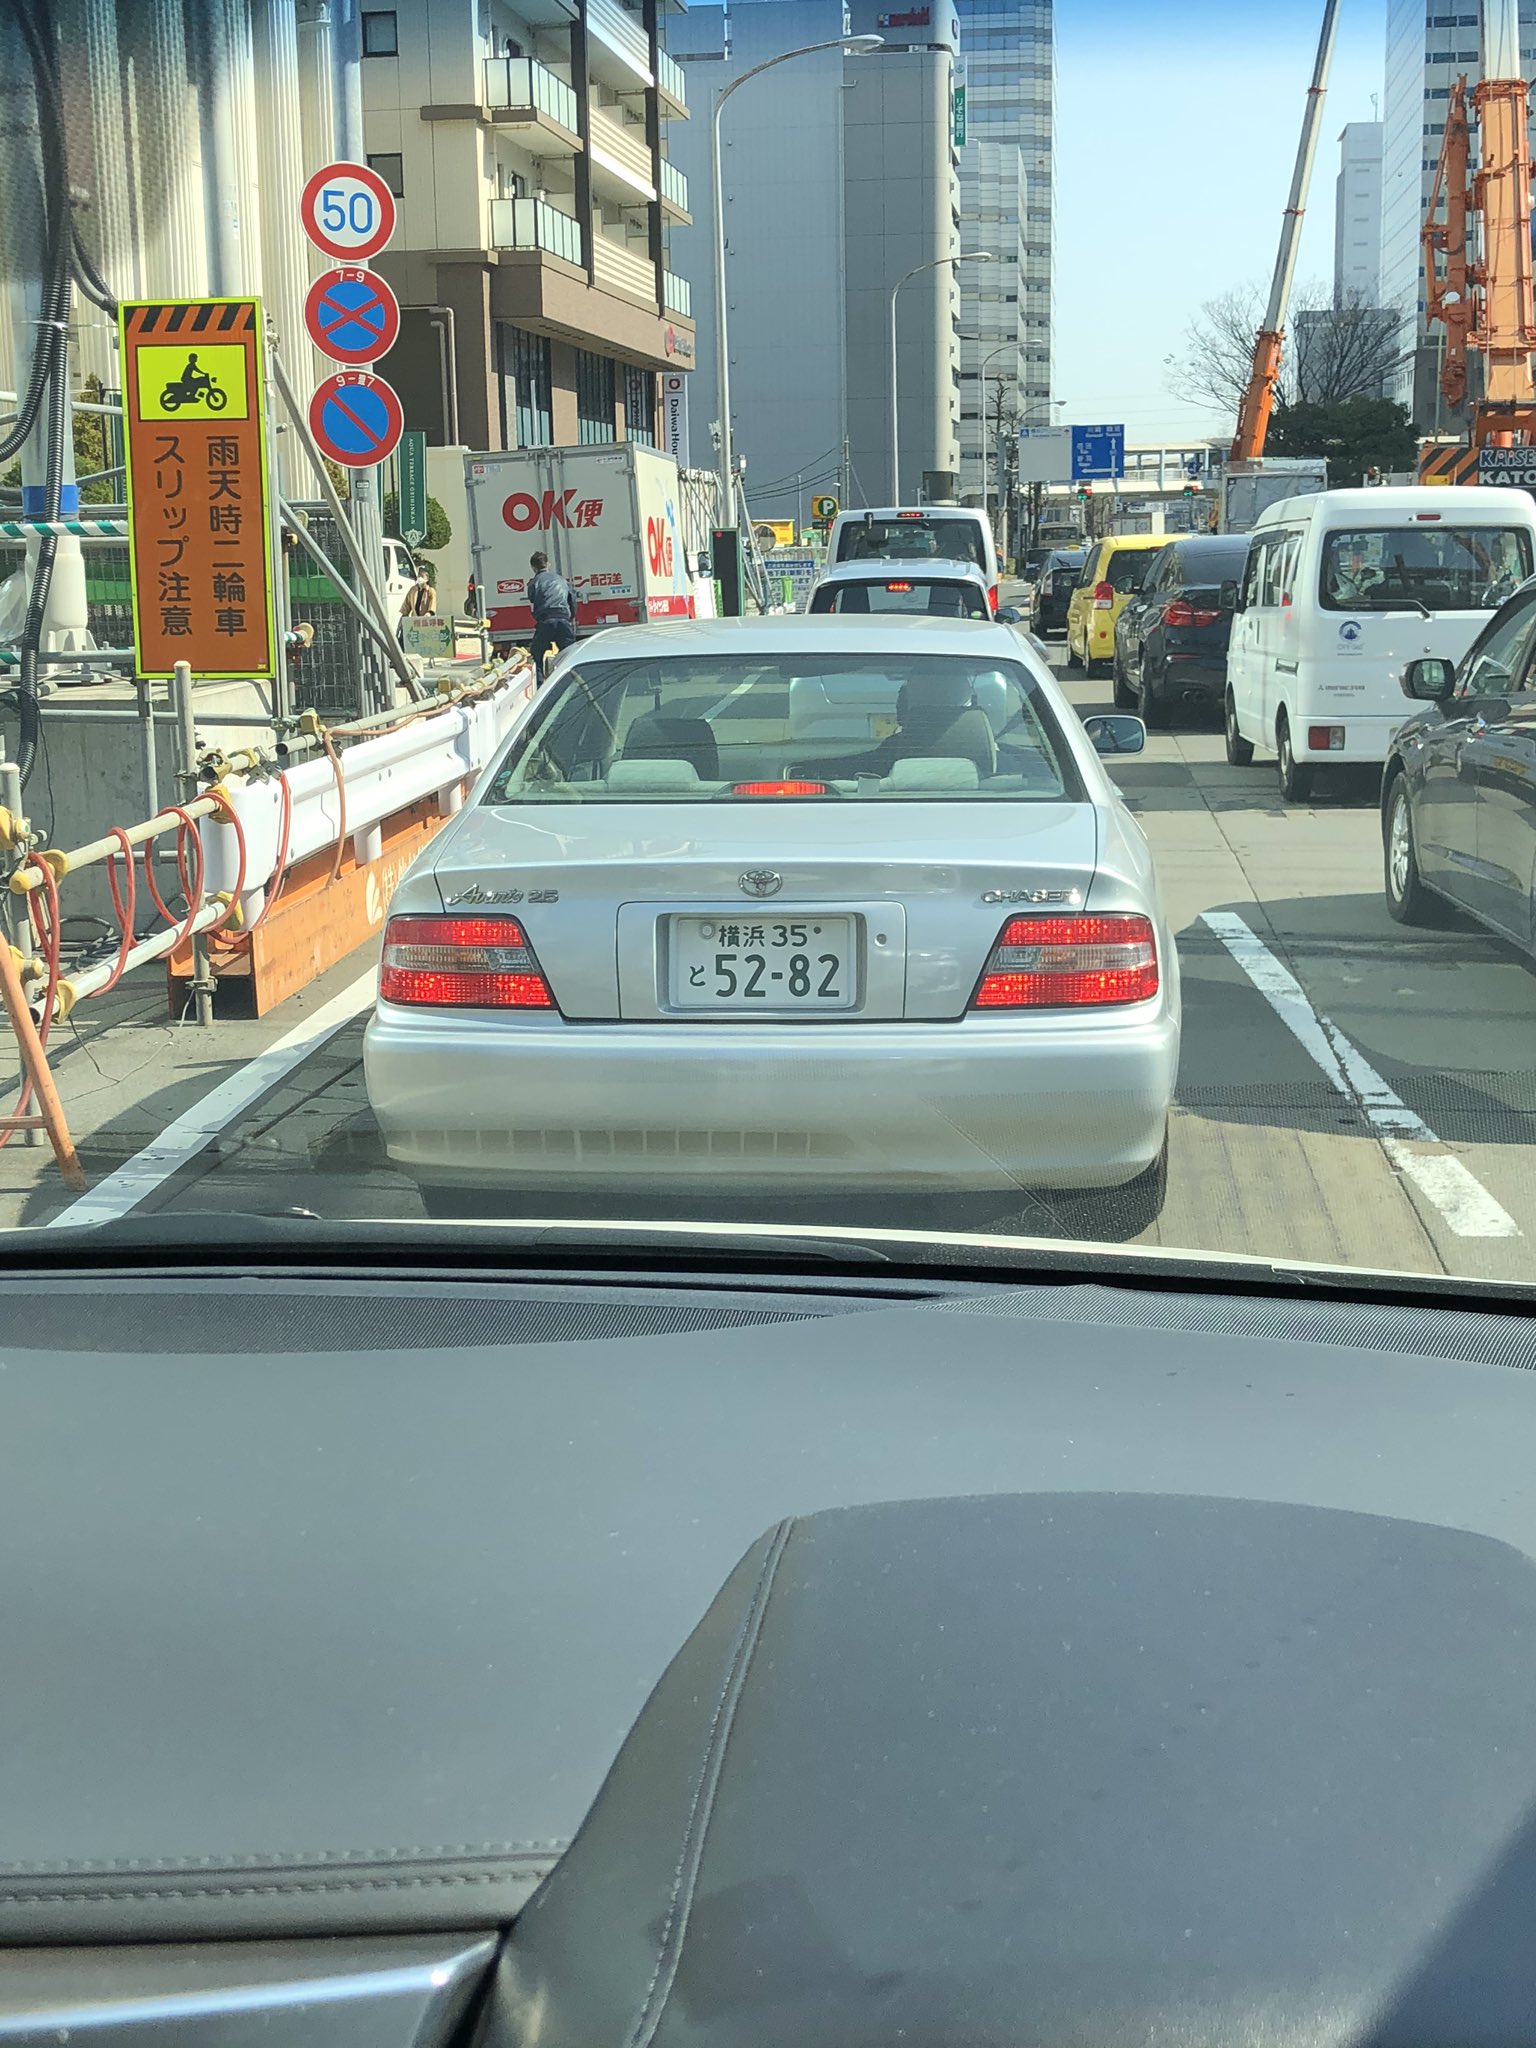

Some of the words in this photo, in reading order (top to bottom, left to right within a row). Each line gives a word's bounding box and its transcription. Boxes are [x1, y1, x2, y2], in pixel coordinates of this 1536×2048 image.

[323, 189, 374, 234] 50
[335, 269, 365, 283] 7-9
[670, 398, 680, 432] Daiwa
[1479, 469, 1536, 484] KATO
[823, 499, 834, 515] P
[153, 435, 193, 637] スリップ注意
[206, 434, 248, 638] 雨天時二輪車
[718, 925, 765, 948] 横浜
[771, 924, 808, 947] 35
[689, 965, 706, 987] と
[715, 953, 840, 998] 52-82
